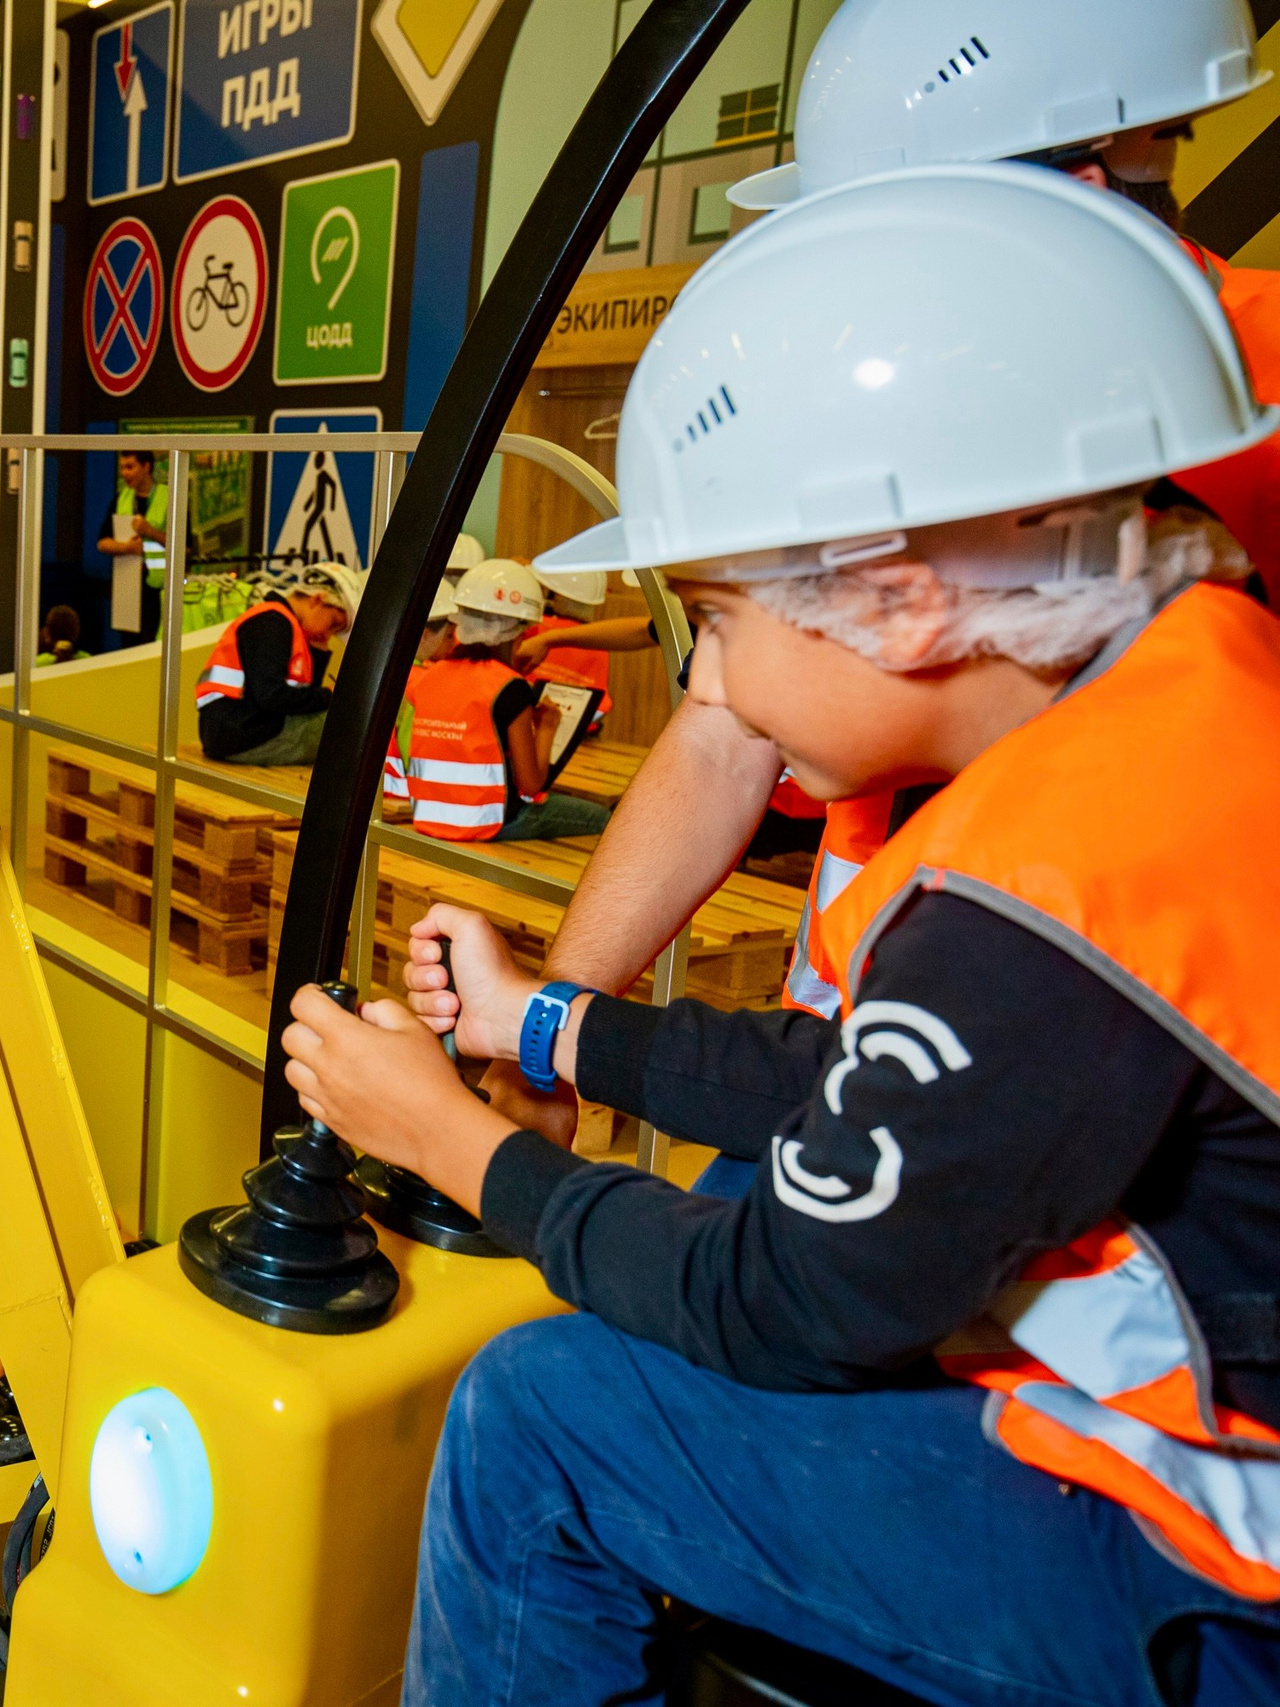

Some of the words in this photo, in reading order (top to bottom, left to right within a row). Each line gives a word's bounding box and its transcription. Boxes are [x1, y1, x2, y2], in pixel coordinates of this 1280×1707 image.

[218, 0, 313, 59] ИГРЫ
[221, 57, 301, 132] ПДД
[306, 322, 353, 350] ЦОДД
[557, 293, 677, 335] ЭКИПИР
